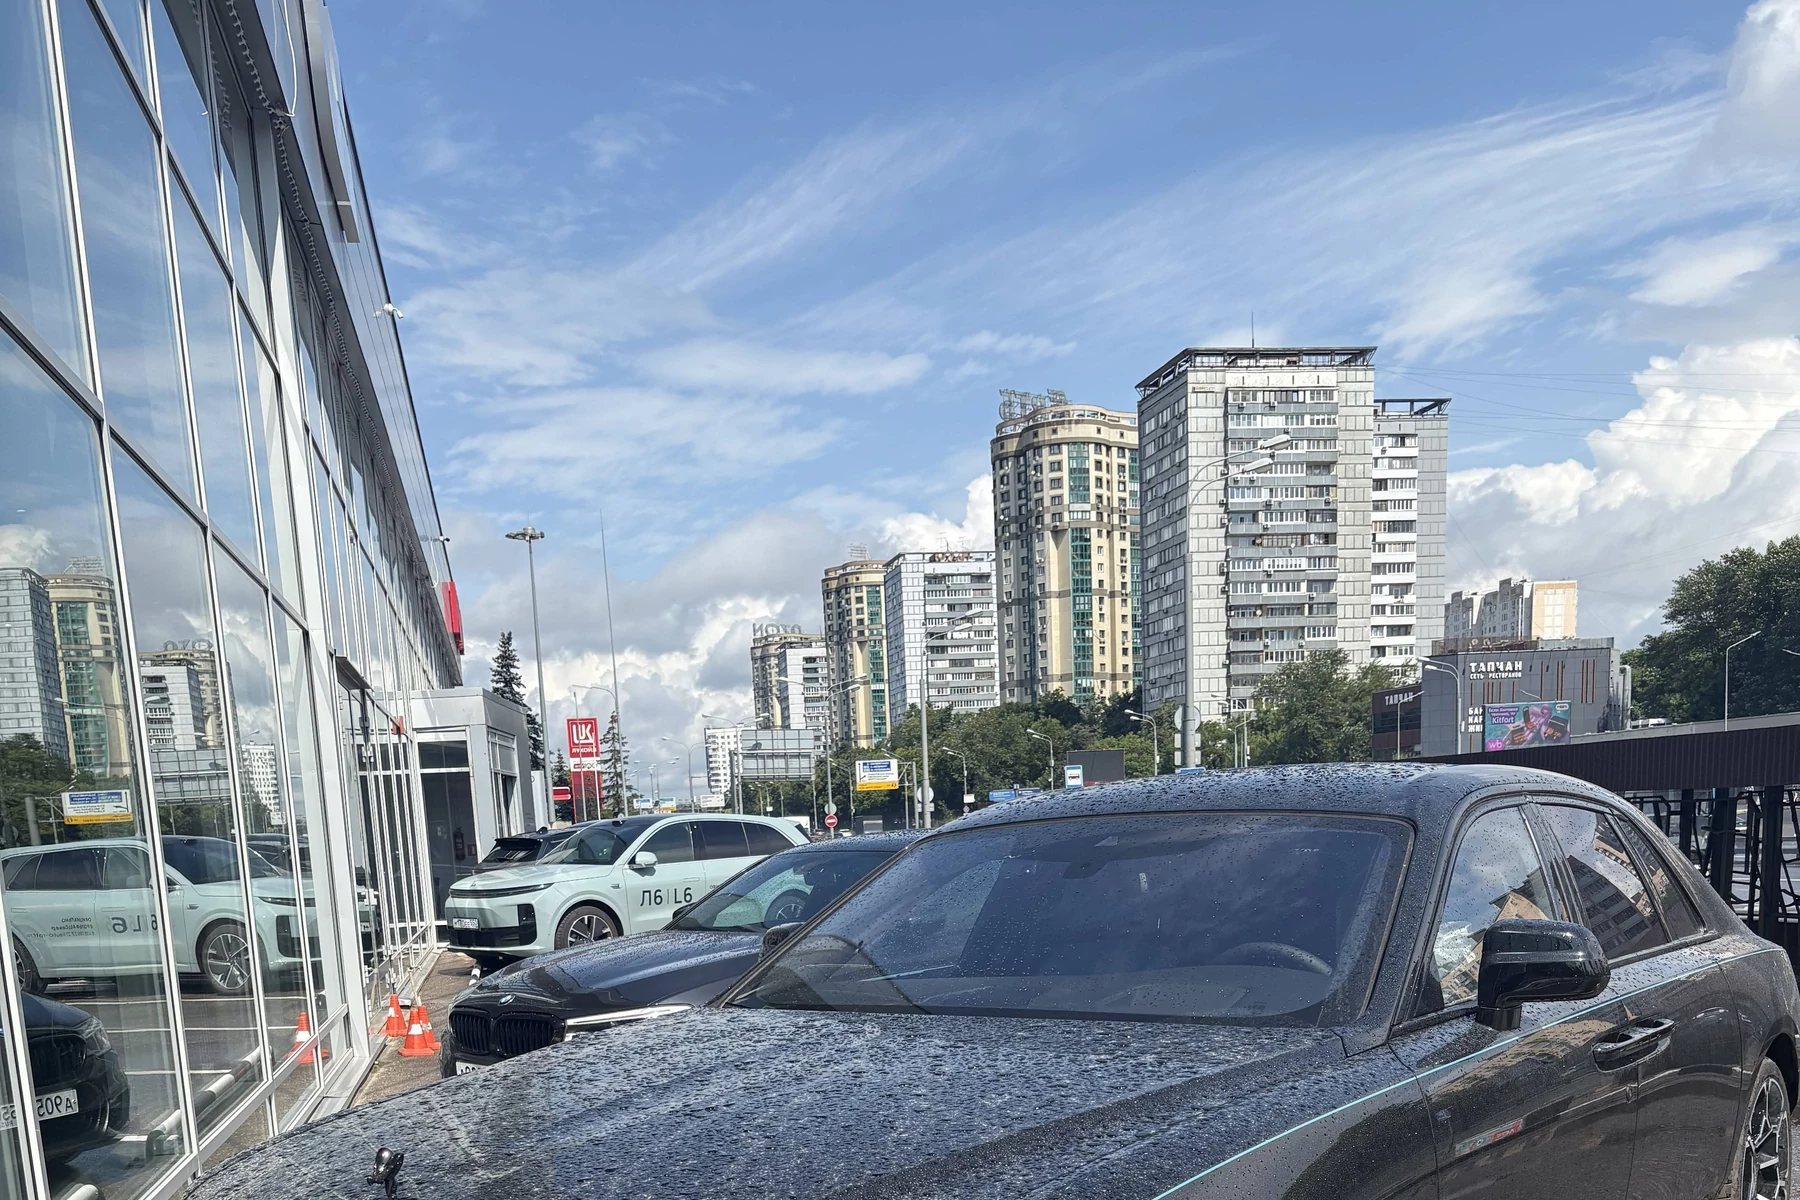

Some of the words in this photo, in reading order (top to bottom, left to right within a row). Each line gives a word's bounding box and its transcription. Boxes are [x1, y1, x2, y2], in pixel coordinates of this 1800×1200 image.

[1469, 660, 1523, 673] ТАПЧАН
[1488, 671, 1522, 679] РЕСТОРАНОВ
[1492, 716, 1515, 724] Kitfort
[640, 889, 663, 907] Л6
[674, 887, 693, 904] L6
